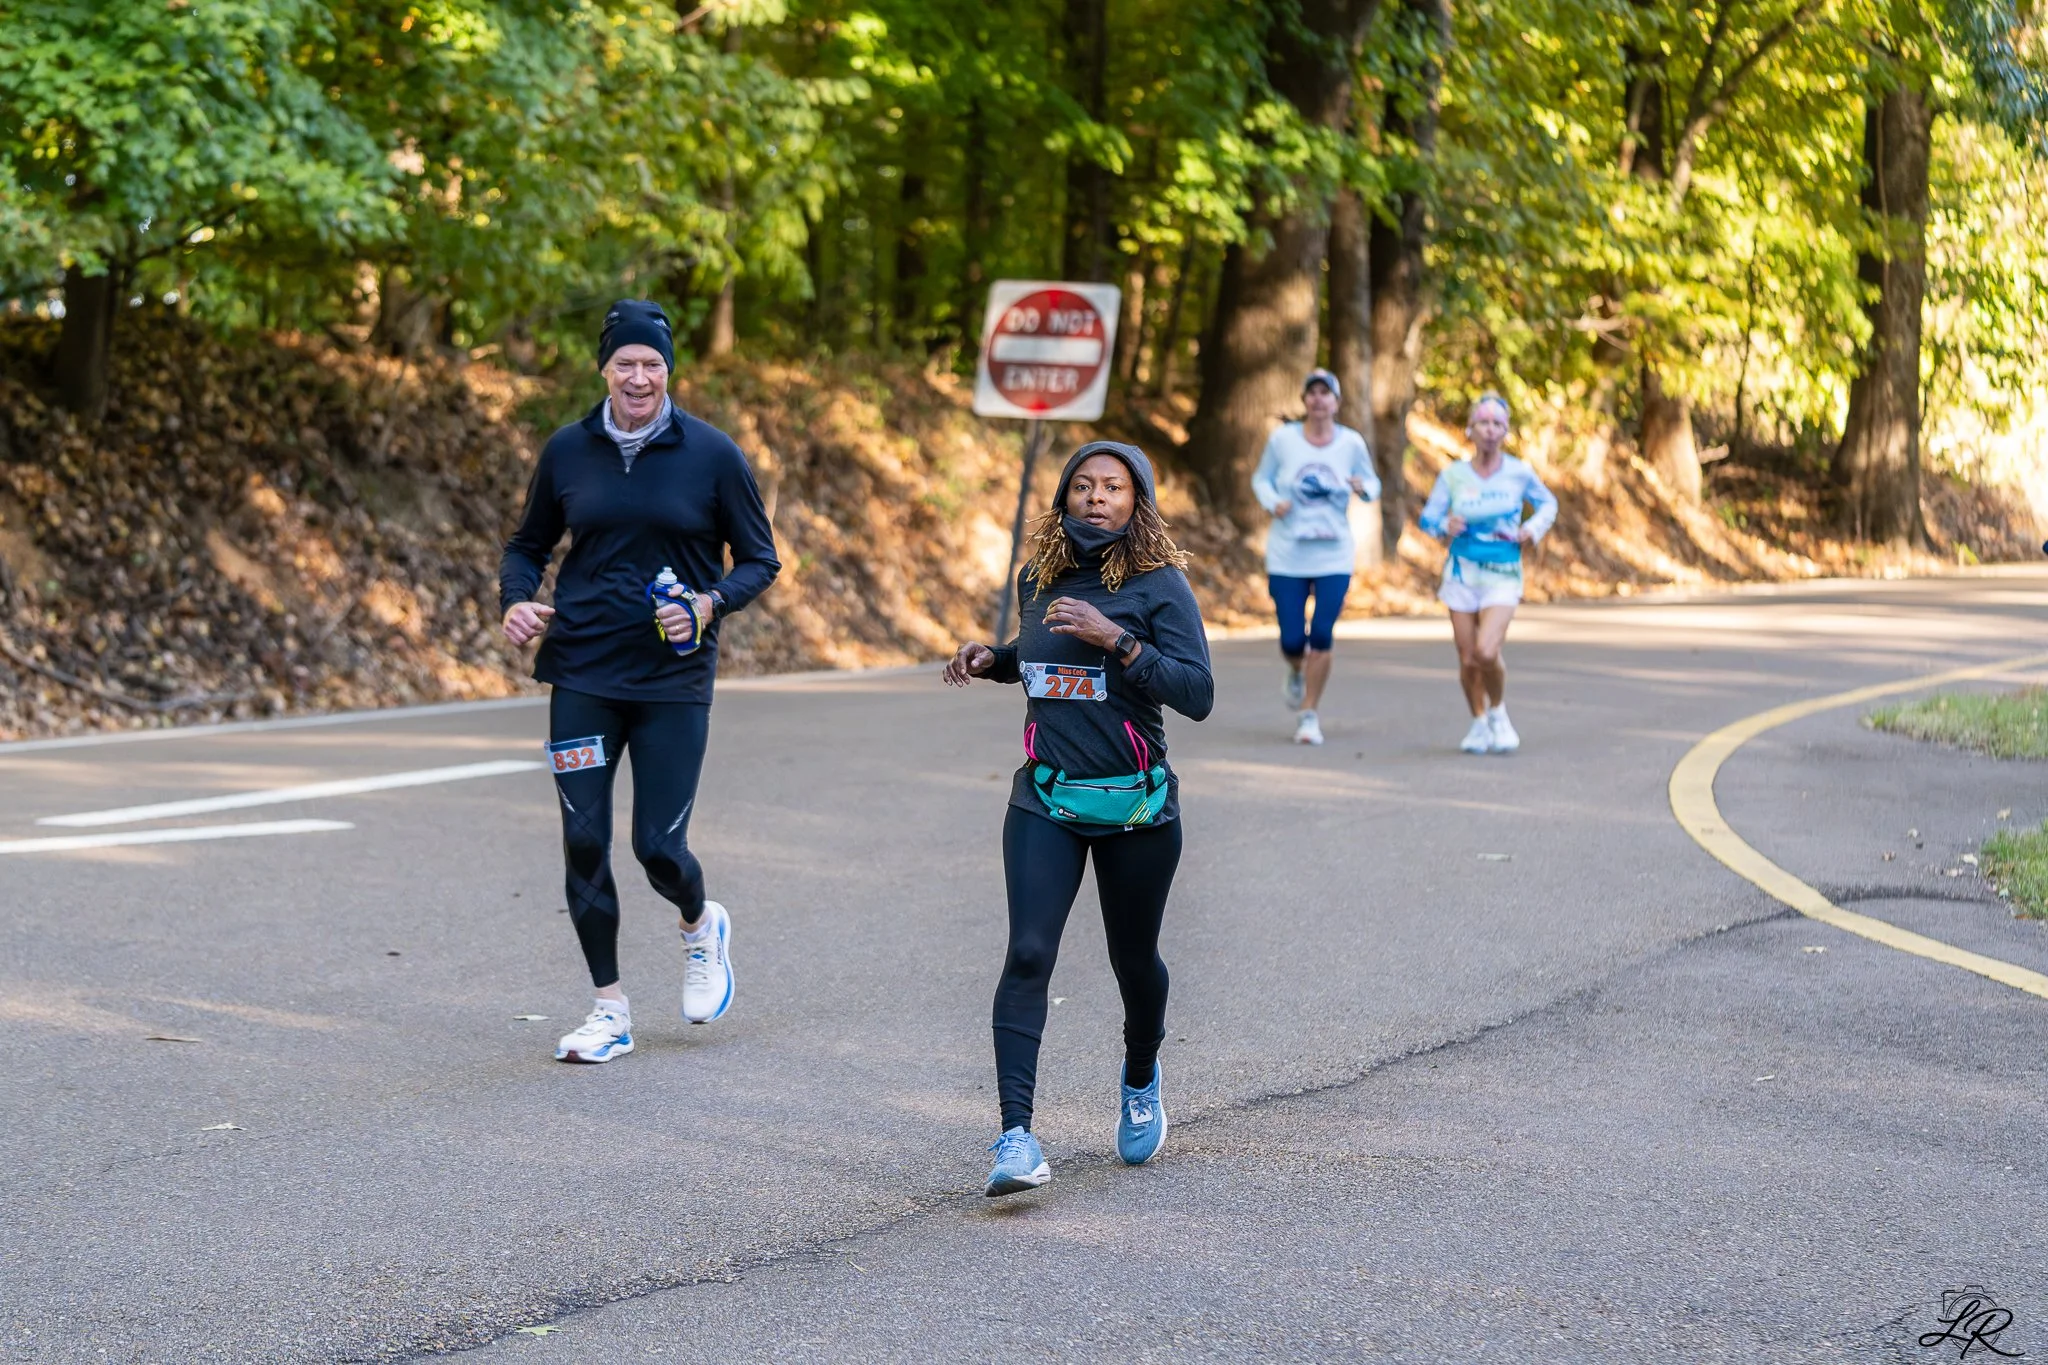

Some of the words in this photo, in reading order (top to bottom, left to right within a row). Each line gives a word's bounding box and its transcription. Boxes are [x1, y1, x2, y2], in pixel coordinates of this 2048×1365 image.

[1005, 307, 1040, 333] DO
[1049, 309, 1096, 336] NOT
[1004, 365, 1079, 393] ENTER
[1057, 666, 1072, 676] Miss
[1044, 675, 1095, 698] 274
[553, 747, 597, 771] 832
